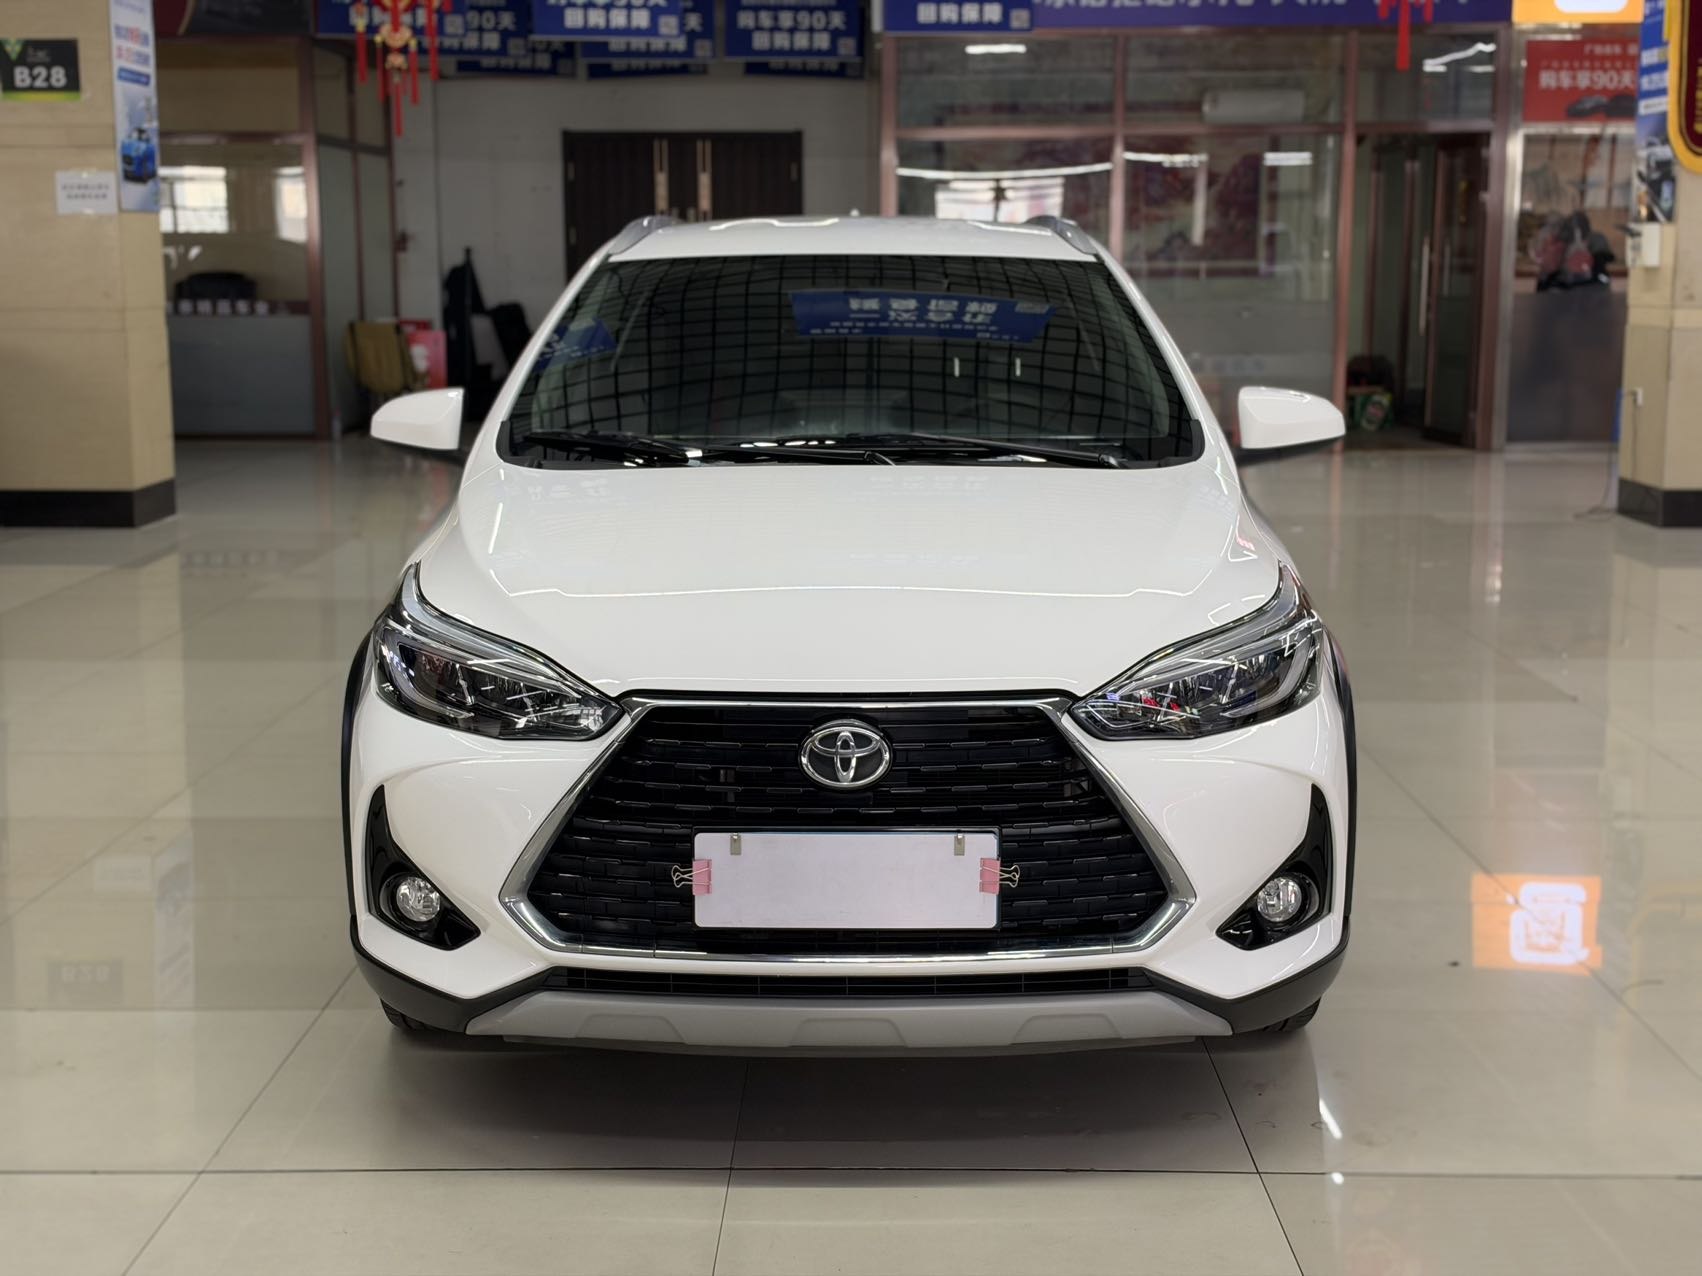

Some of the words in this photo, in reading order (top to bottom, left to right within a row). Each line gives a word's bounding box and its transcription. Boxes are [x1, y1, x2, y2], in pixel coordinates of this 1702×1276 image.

[564, 8, 651, 29] 回购保障
[736, 9, 846, 29] 购车享90天
[917, 3, 1002, 23] 回购保障
[752, 31, 831, 50] 回购保障
[13, 65, 67, 88] B28
